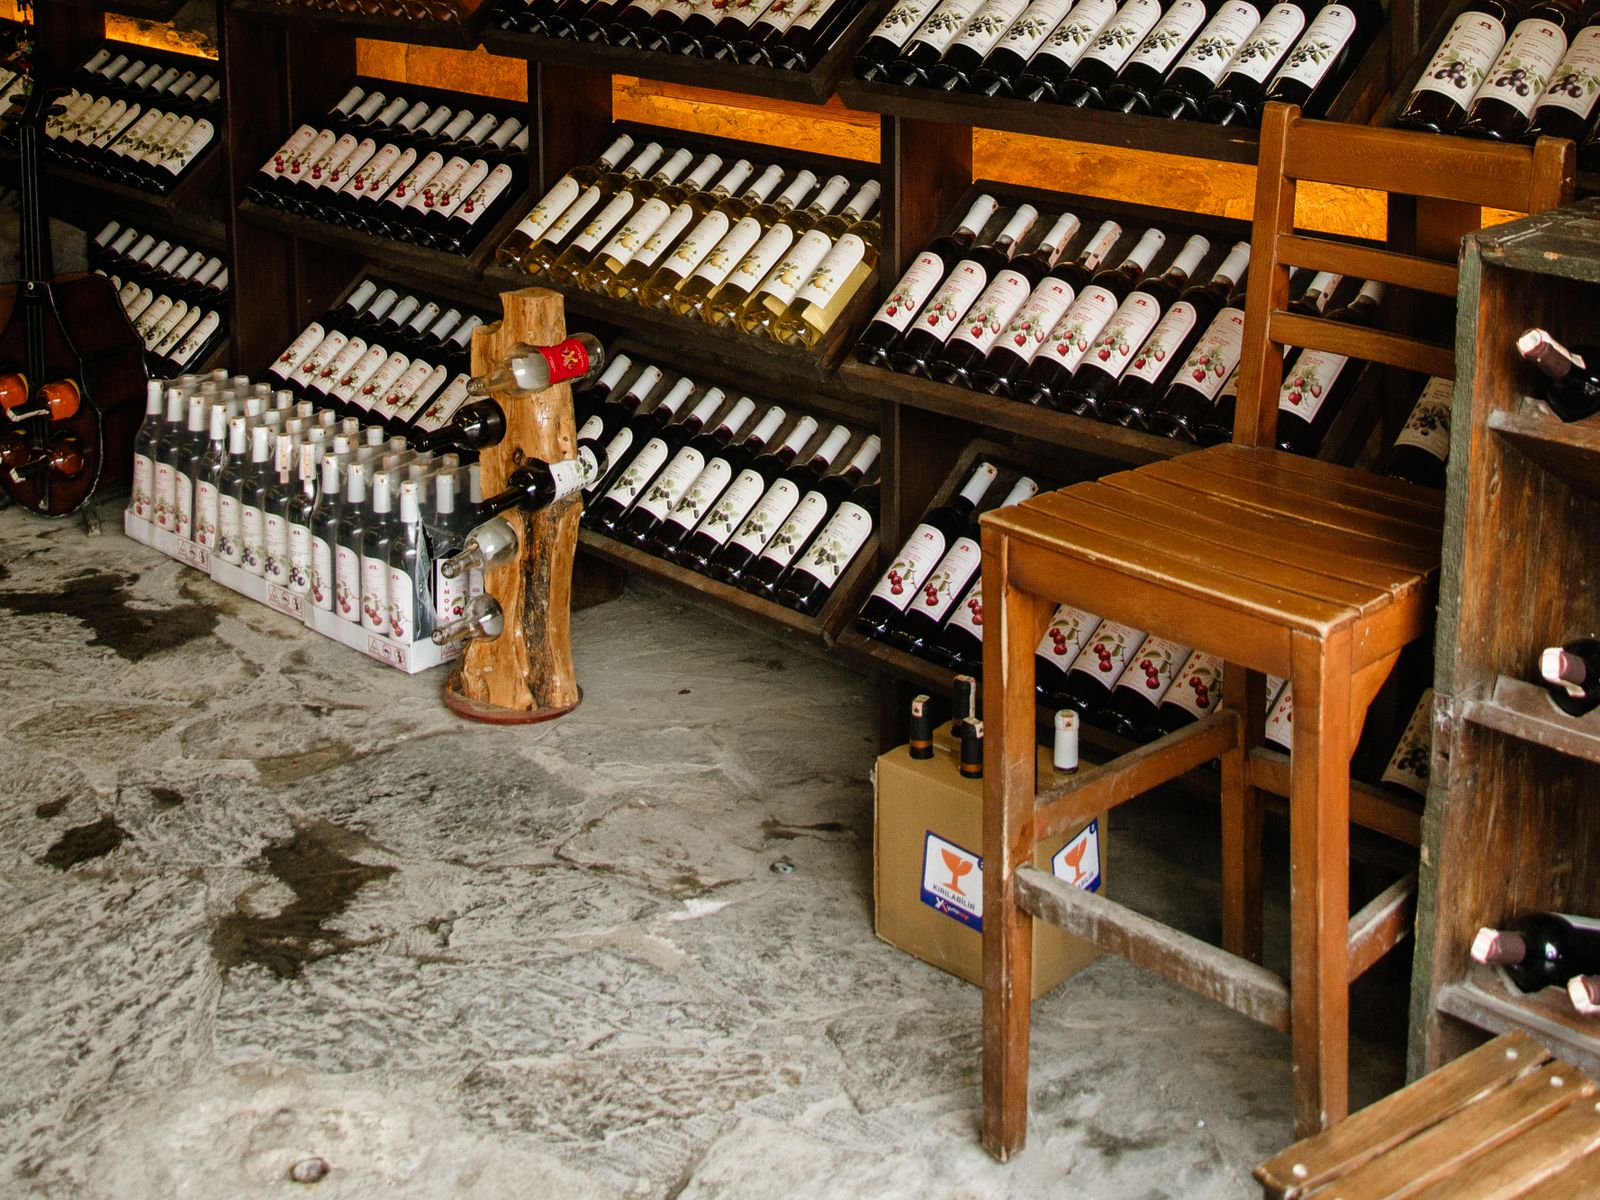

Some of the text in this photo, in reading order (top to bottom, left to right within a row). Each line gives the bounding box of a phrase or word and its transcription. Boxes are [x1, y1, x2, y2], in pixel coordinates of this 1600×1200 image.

[1425, 24, 1462, 78] VINOVA
[1486, 31, 1522, 85] VINOVA
[443, 580, 451, 622] INOVA
[1174, 652, 1202, 689] NOVA
